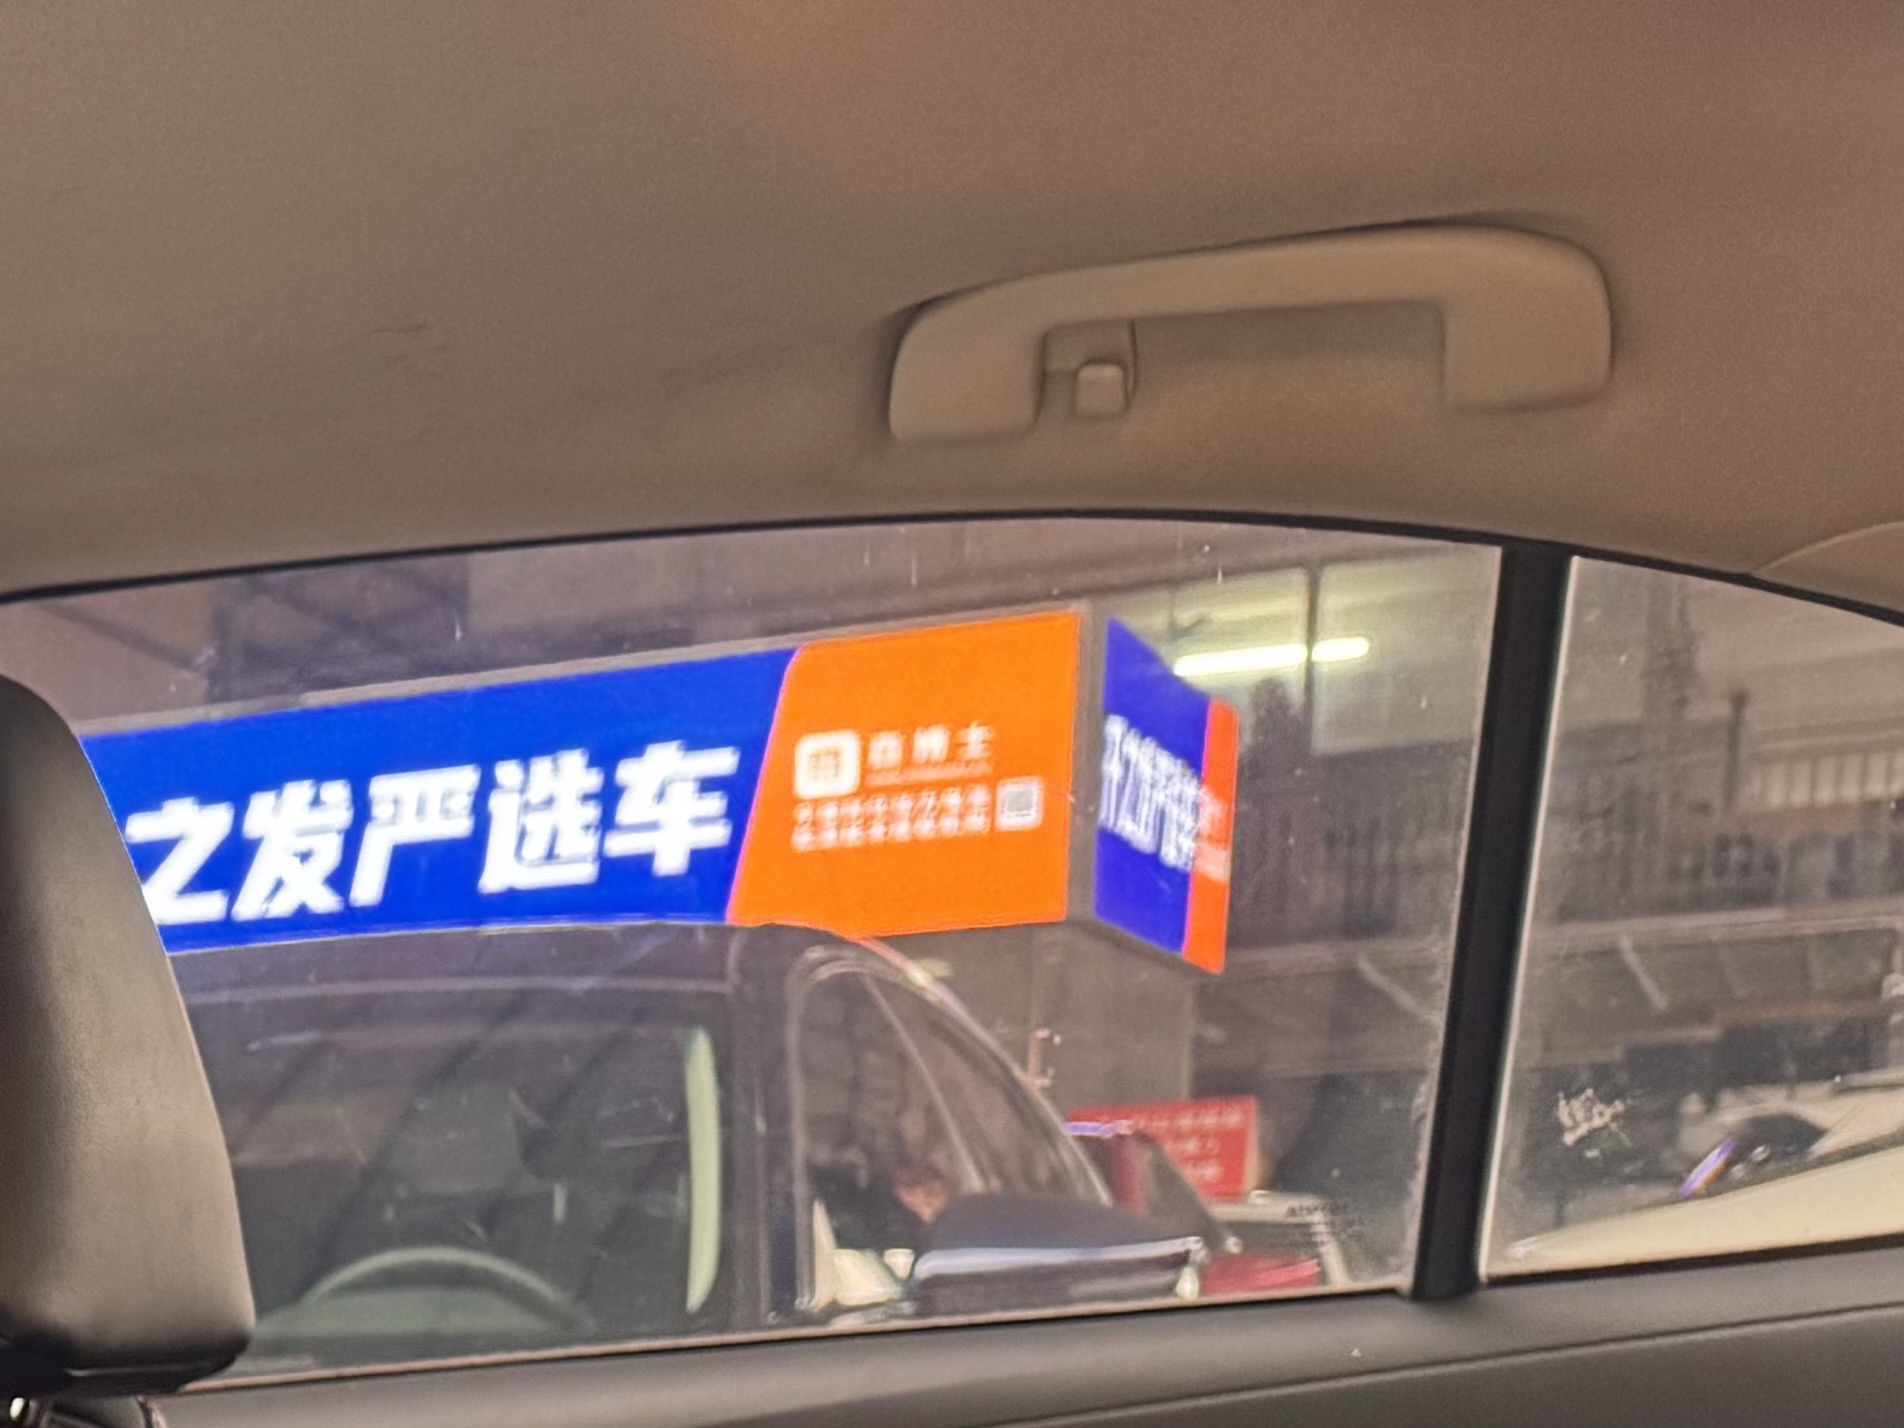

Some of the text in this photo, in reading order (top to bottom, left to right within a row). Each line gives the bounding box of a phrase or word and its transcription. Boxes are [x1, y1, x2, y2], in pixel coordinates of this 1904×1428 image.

[125, 740, 741, 925] 之发严选车
